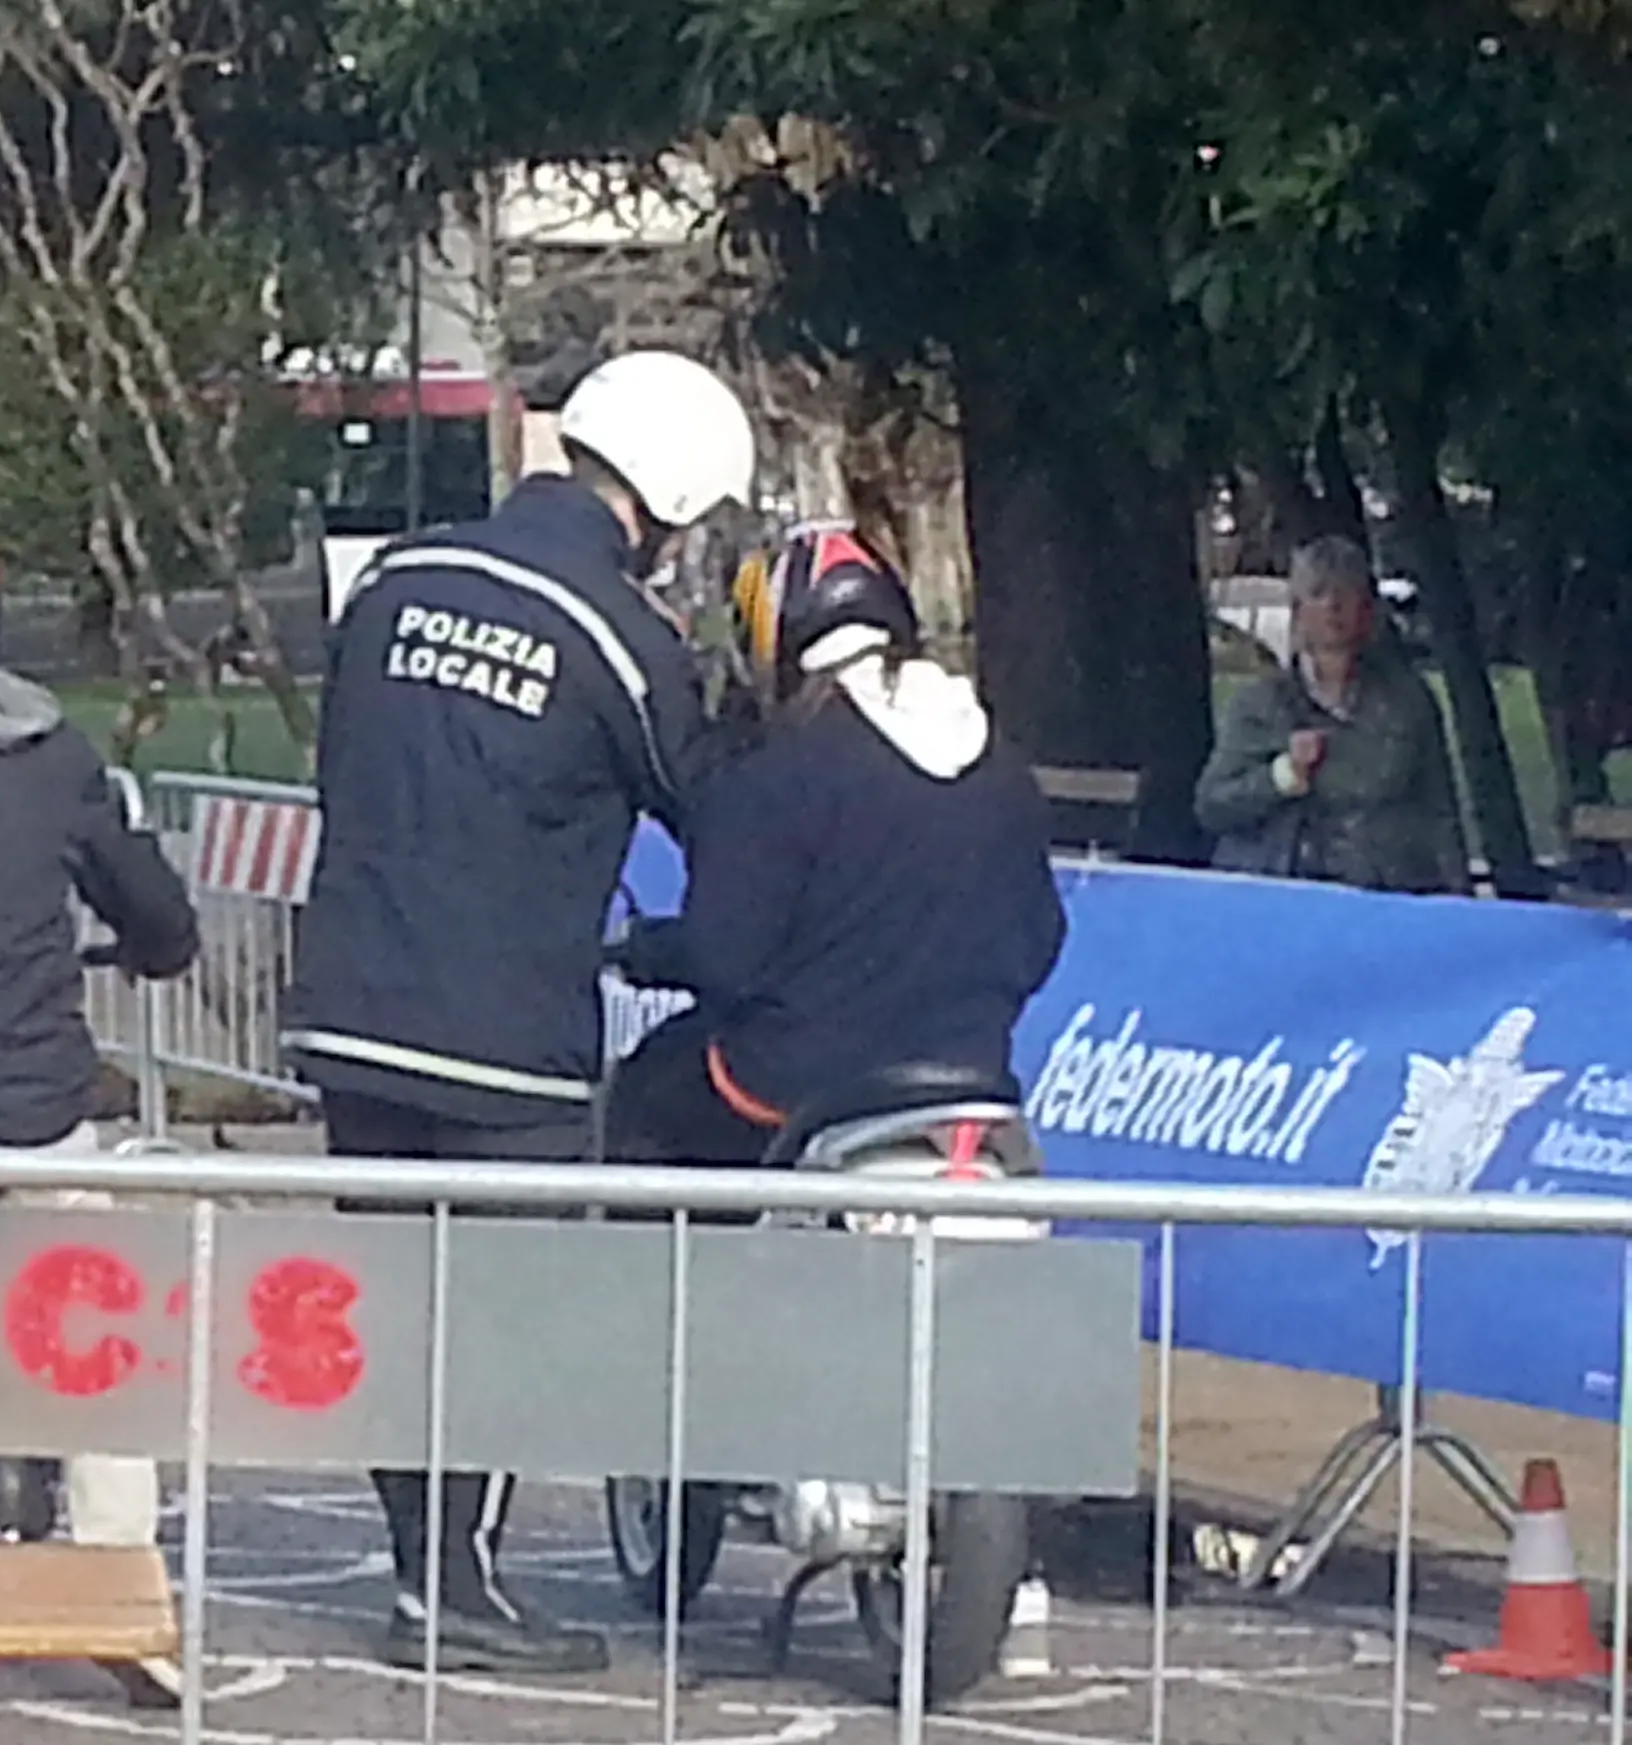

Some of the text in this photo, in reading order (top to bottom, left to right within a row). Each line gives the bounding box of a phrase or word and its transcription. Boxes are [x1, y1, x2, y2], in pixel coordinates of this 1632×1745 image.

[397, 606, 557, 678] POLIZIA
[387, 643, 549, 716] LOCALE
[1026, 1003, 1365, 1162] federmoto.it
